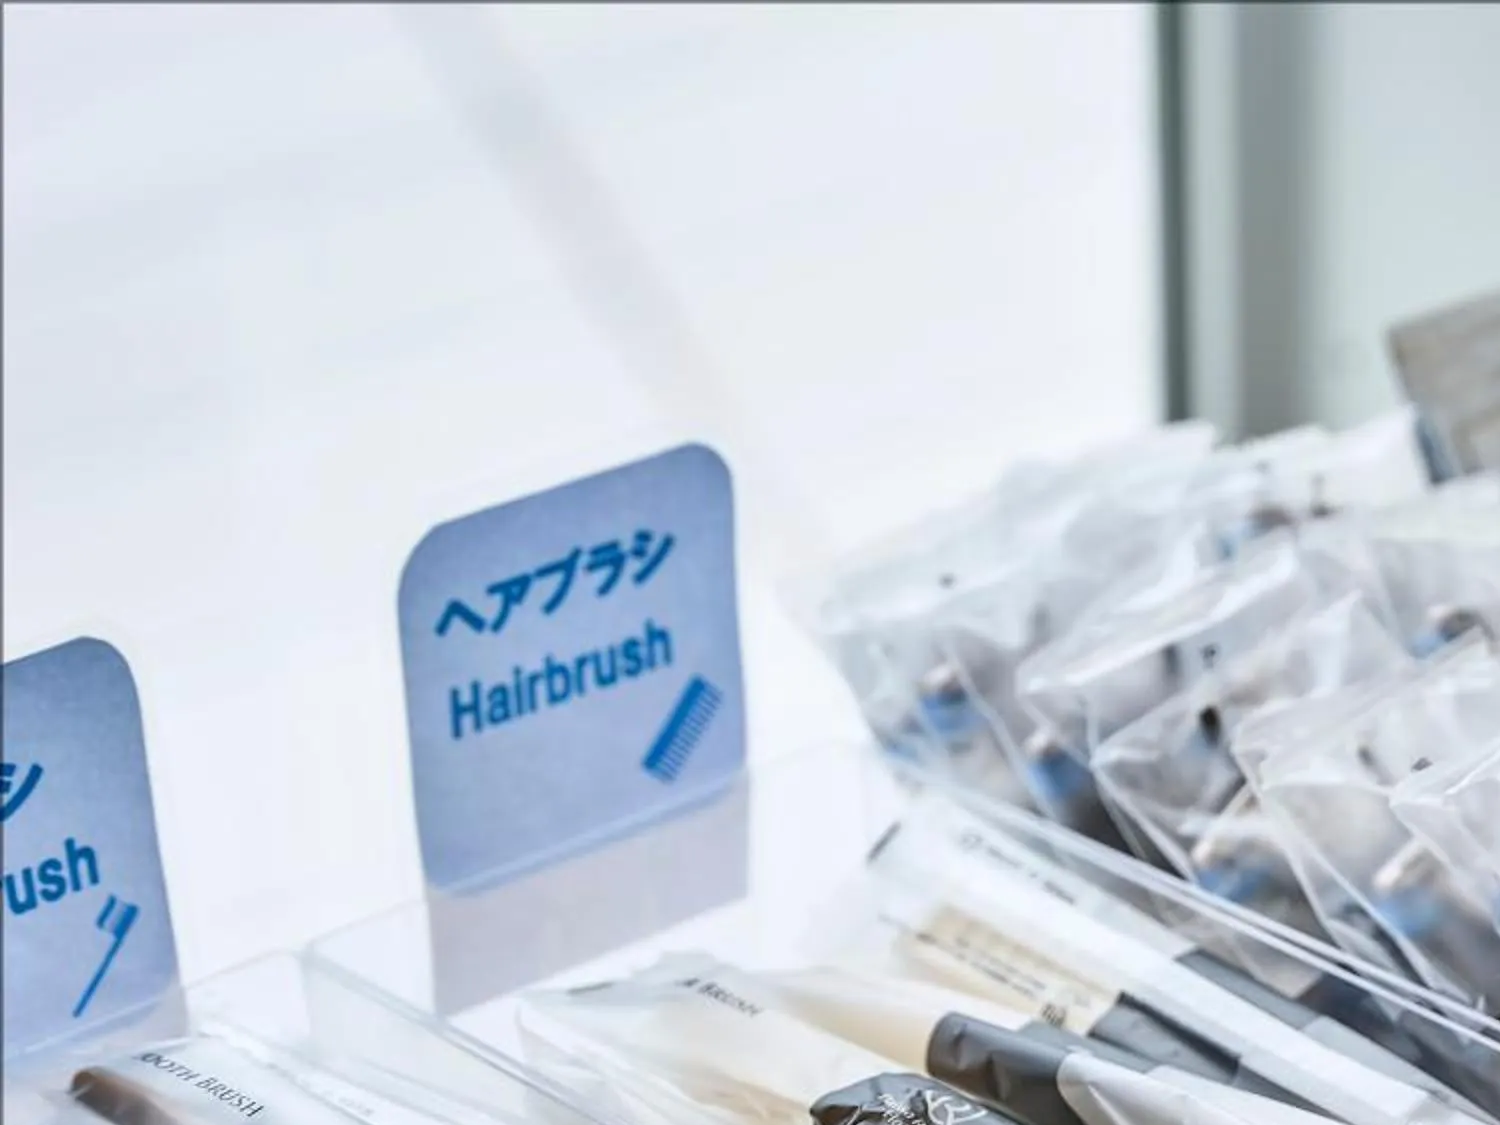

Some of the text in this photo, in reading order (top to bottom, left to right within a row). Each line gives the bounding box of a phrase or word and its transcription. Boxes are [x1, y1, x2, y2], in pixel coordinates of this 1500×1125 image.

[434, 528, 676, 637] ヘアブラシ
[449, 617, 674, 740] Hairbrush
[0, 836, 101, 916] ush
[133, 1051, 265, 1118] OOTH BRUSH
